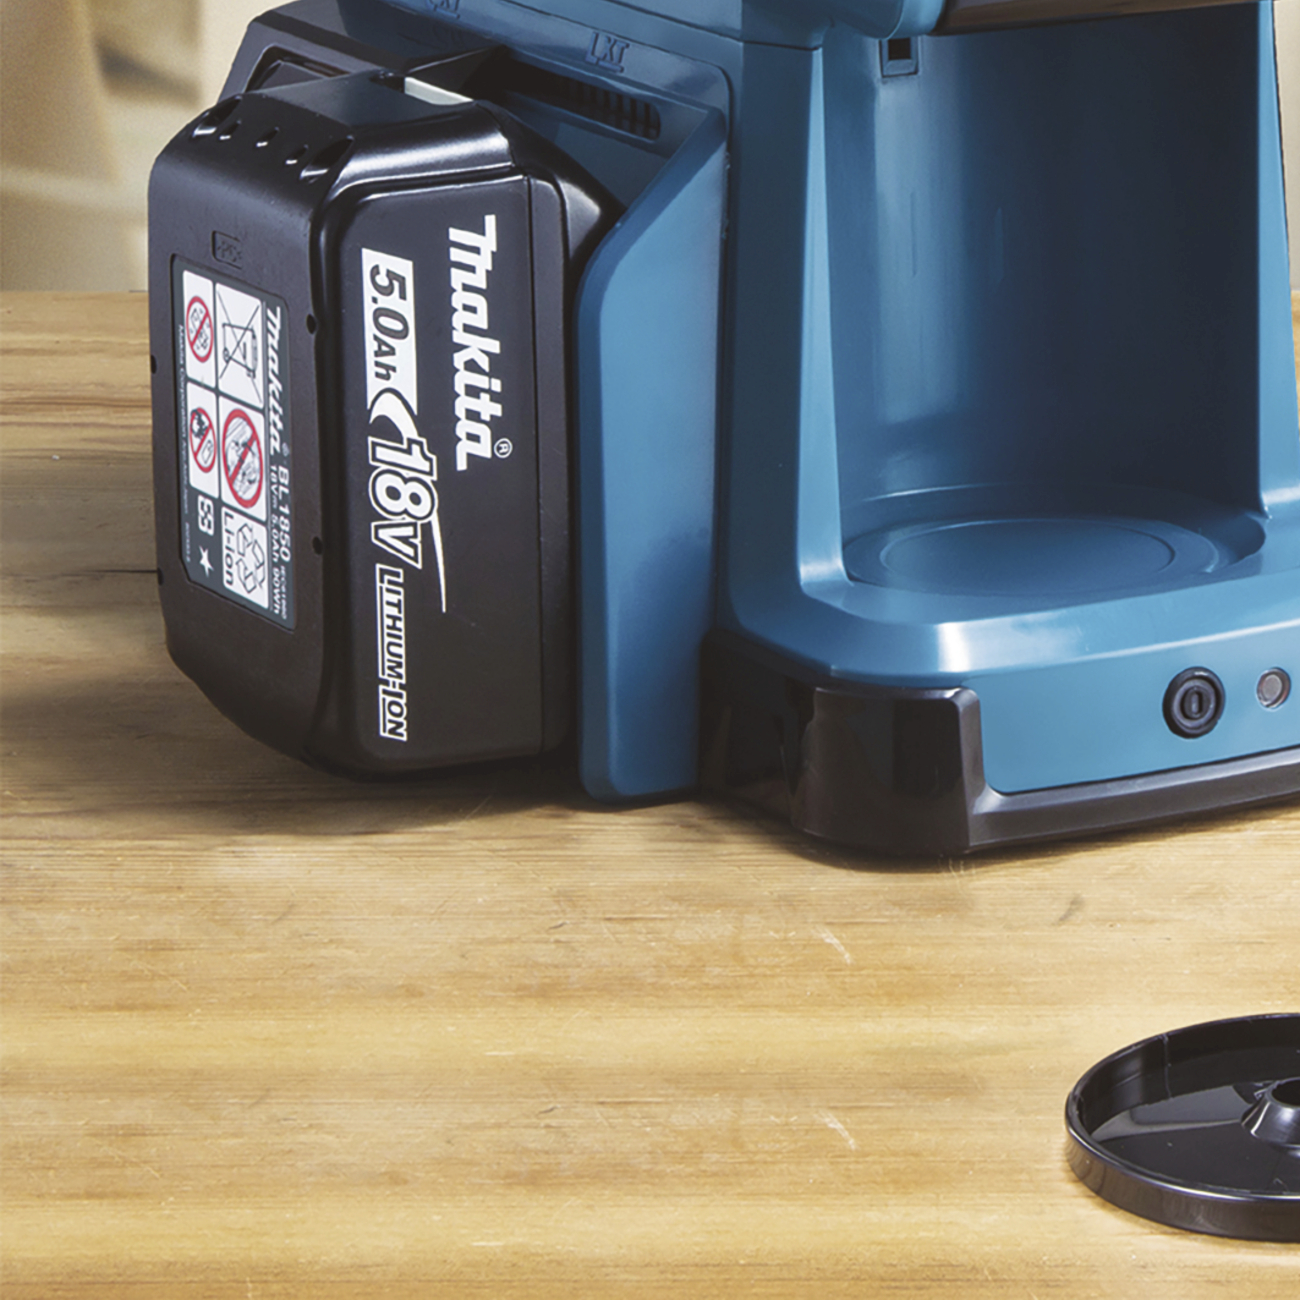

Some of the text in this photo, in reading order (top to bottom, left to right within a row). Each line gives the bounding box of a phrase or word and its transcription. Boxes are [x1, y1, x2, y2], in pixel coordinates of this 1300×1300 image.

[585, 31, 630, 73] LXT
[266, 306, 284, 456] makita
[449, 214, 503, 471] makita
[224, 512, 235, 586] Li-ion
[278, 465, 291, 563] BL1850
[368, 264, 439, 741] 5.0Ah 18V LITHIUM-ION
